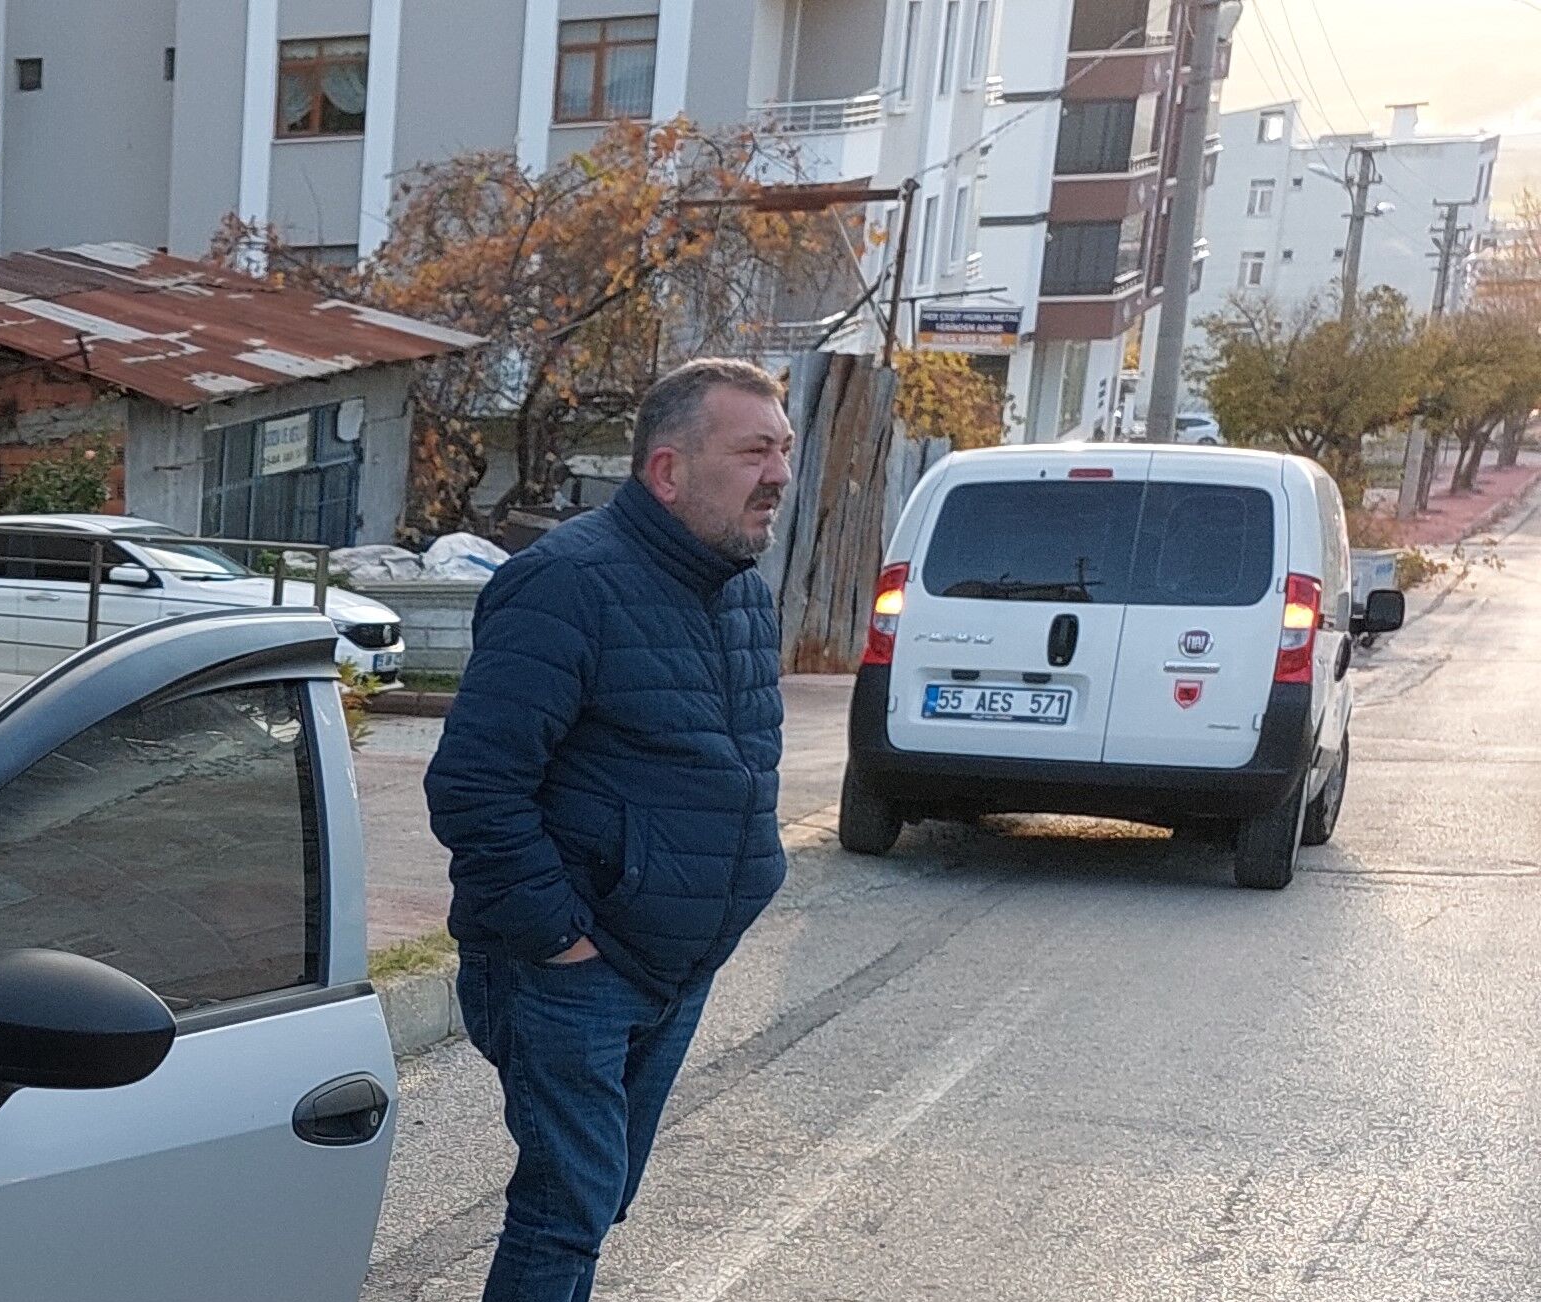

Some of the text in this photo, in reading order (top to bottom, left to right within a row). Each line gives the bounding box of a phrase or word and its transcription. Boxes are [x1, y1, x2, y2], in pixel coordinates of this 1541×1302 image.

[937, 690, 1065, 716] 55 AES 571
